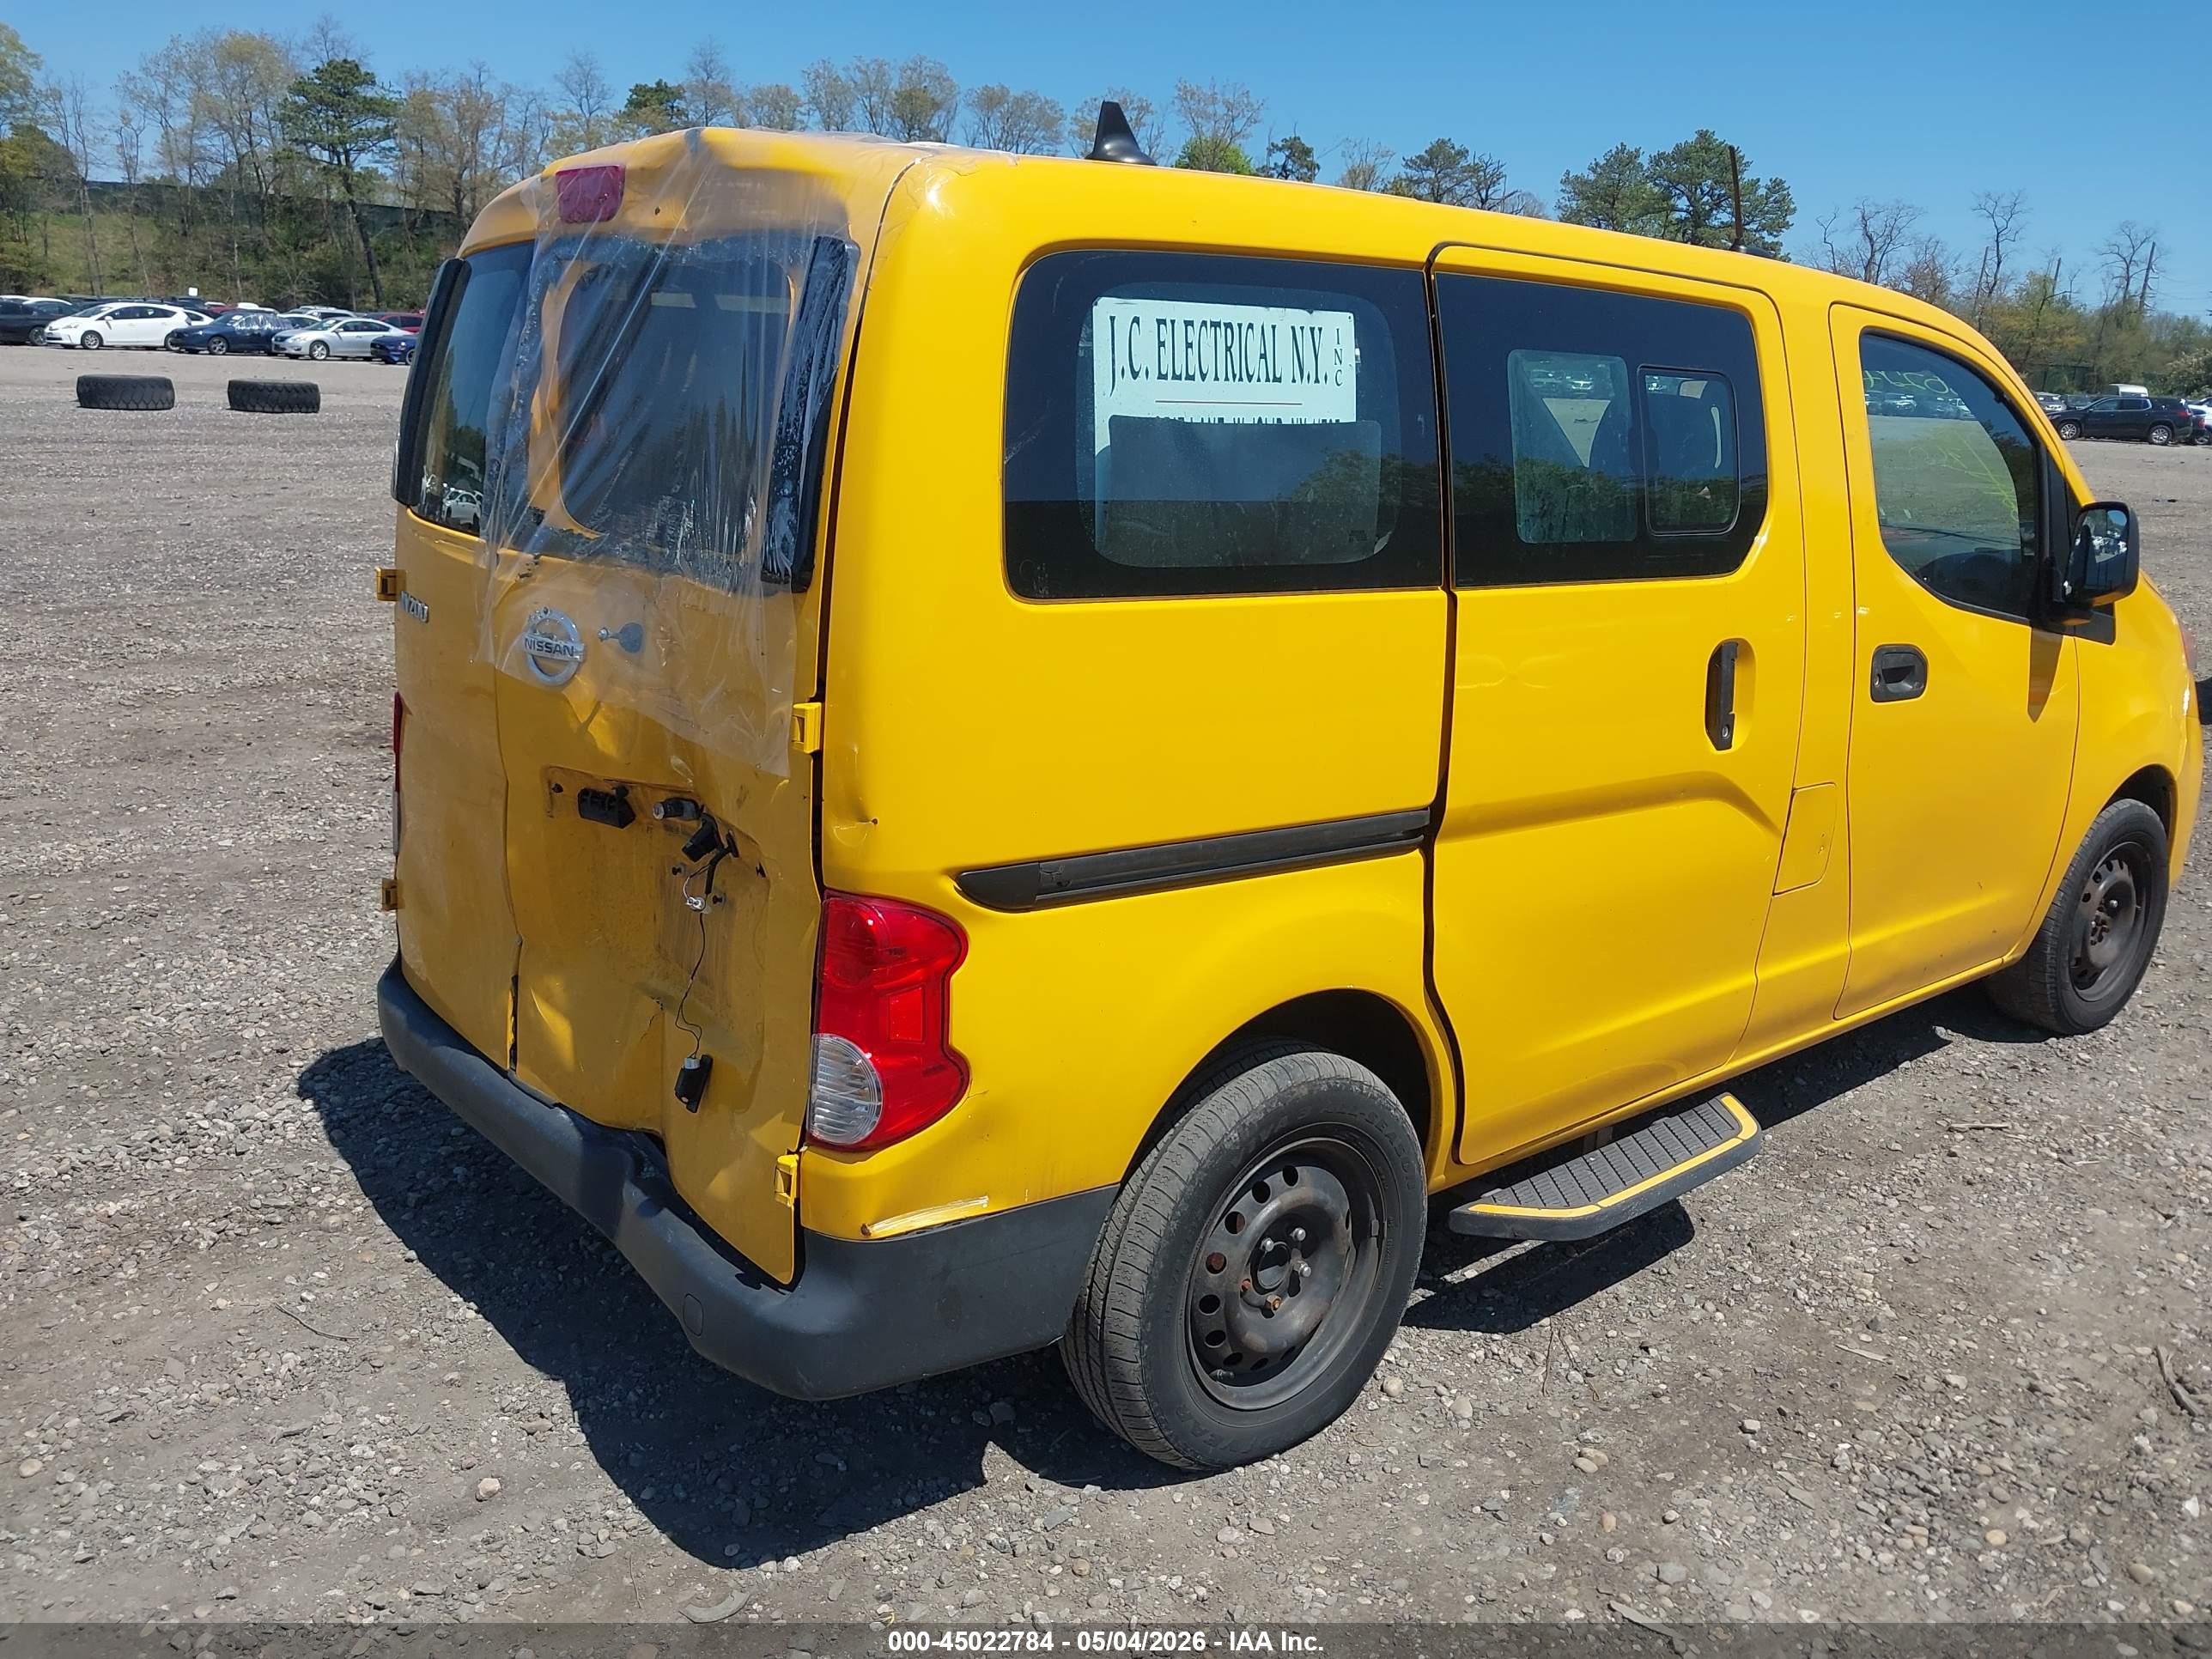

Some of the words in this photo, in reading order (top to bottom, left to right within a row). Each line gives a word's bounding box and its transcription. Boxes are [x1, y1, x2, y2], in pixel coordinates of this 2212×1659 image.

[1109, 315, 1149, 398] J.C.
[1156, 318, 1283, 384] ELECTRICAL
[1291, 325, 1328, 385] N.Y.
[1334, 327, 1344, 386] INC
[524, 637, 575, 658] NISSAN
